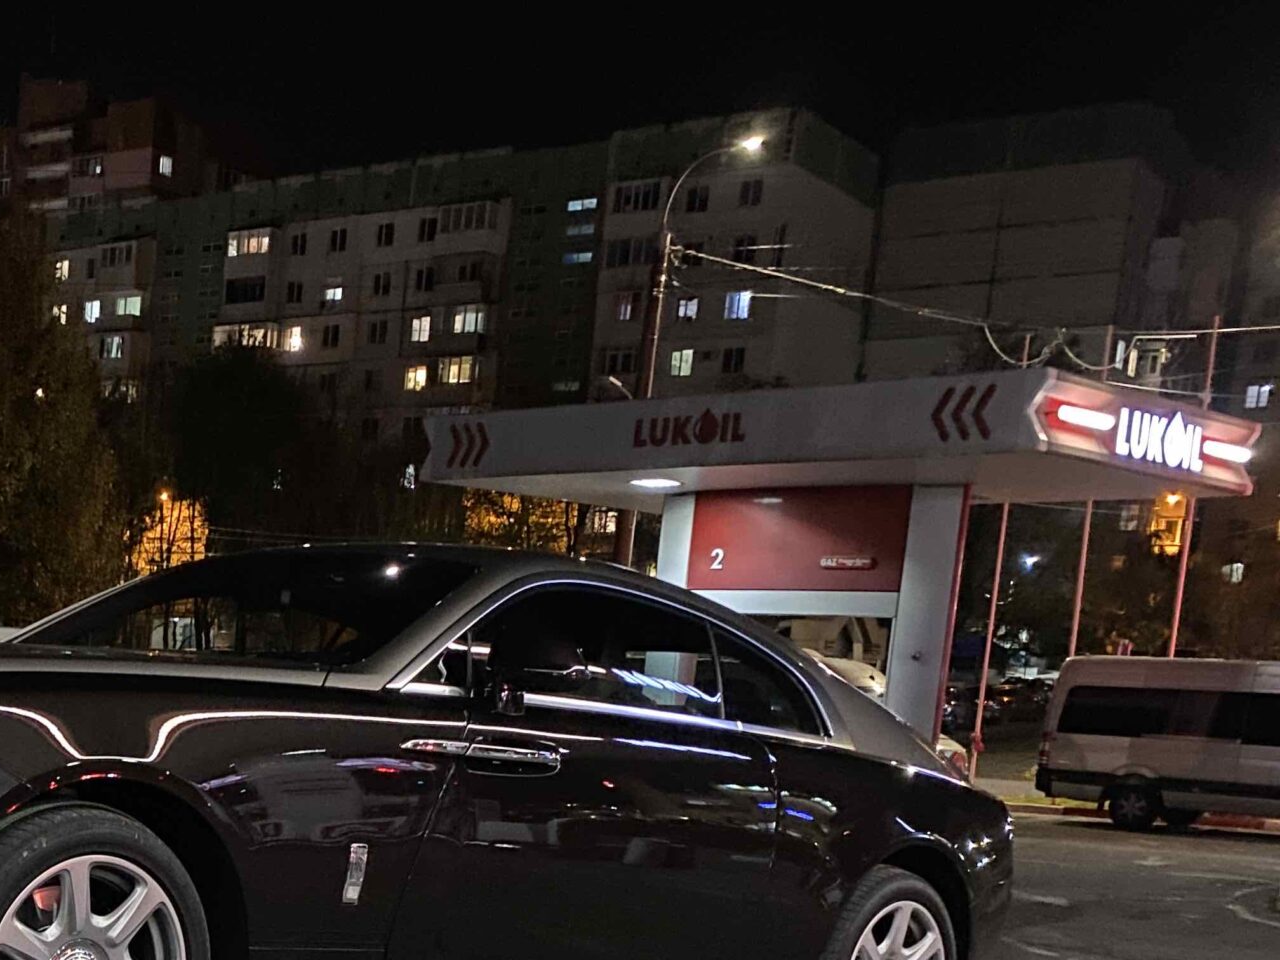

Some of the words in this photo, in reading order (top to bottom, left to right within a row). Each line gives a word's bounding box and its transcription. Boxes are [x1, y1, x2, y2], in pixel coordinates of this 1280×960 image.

[633, 408, 745, 448] LUKOIL
[1115, 407, 1203, 472] LUKOIL
[709, 548, 725, 570] 2
